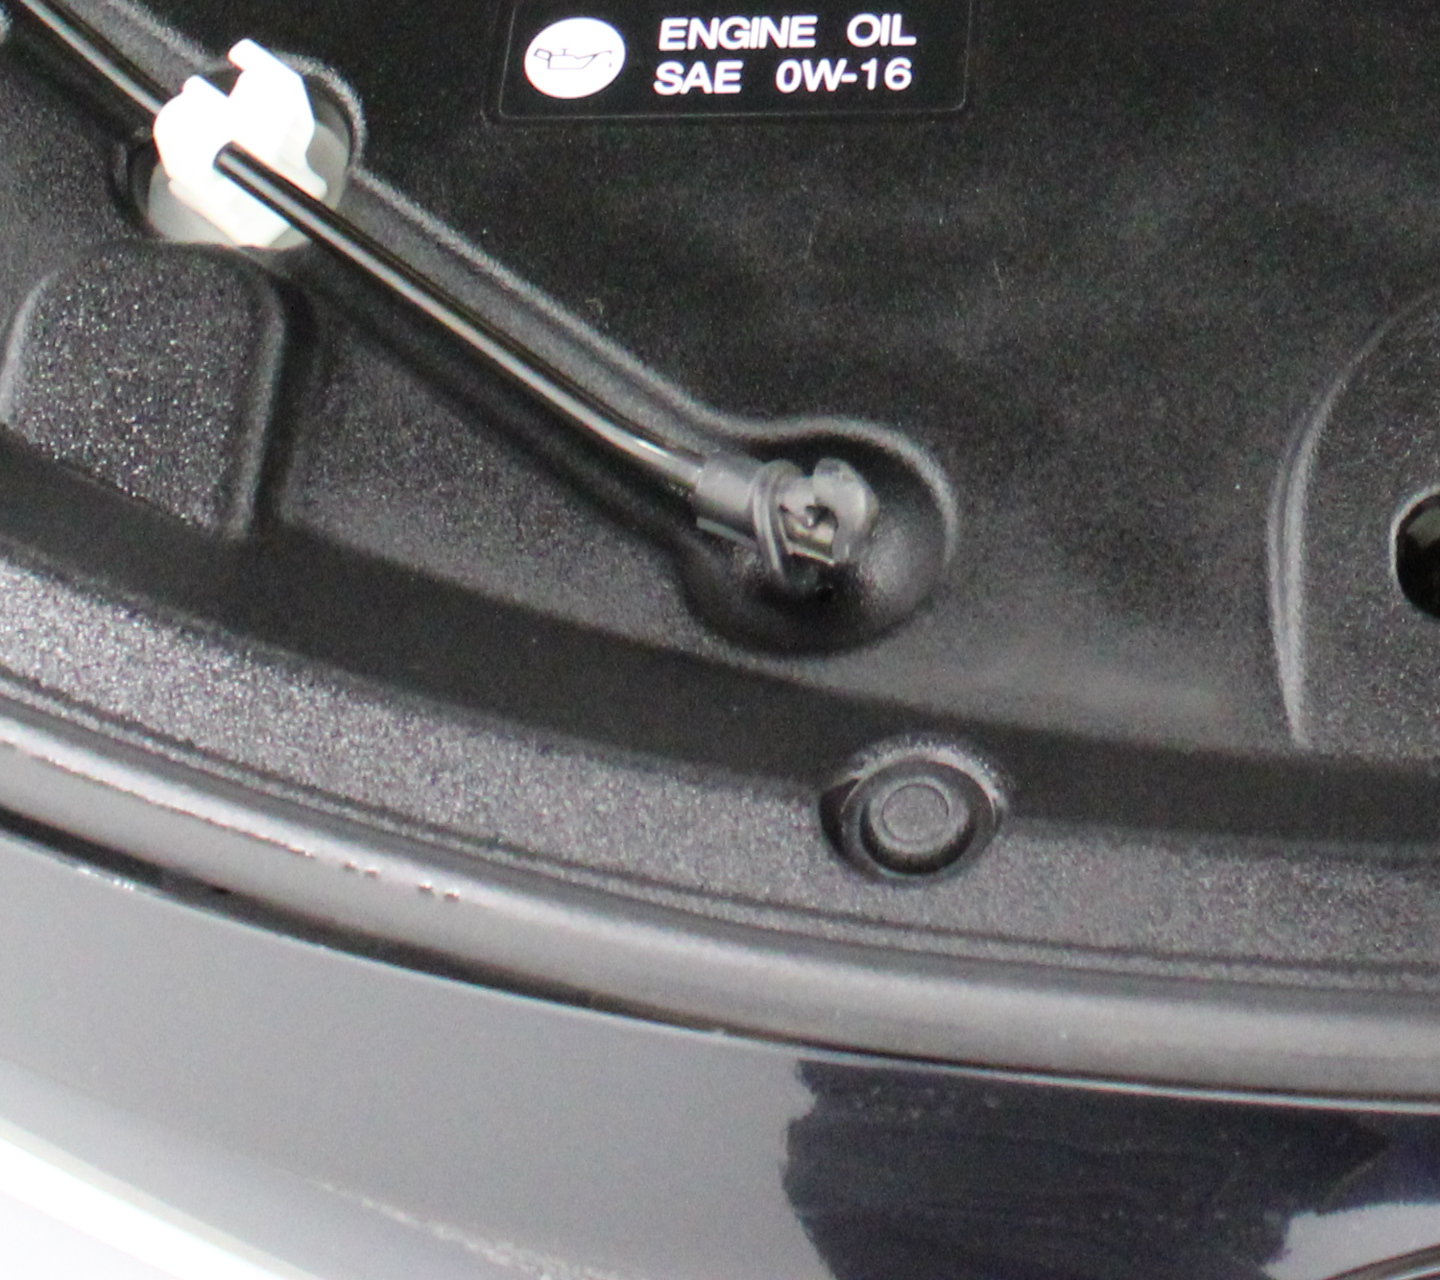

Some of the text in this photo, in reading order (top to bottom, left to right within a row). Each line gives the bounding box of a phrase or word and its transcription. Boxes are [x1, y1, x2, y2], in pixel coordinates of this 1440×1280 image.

[658, 12, 917, 51] ENGINE OIL
[653, 56, 913, 95] SAE 0W-16
